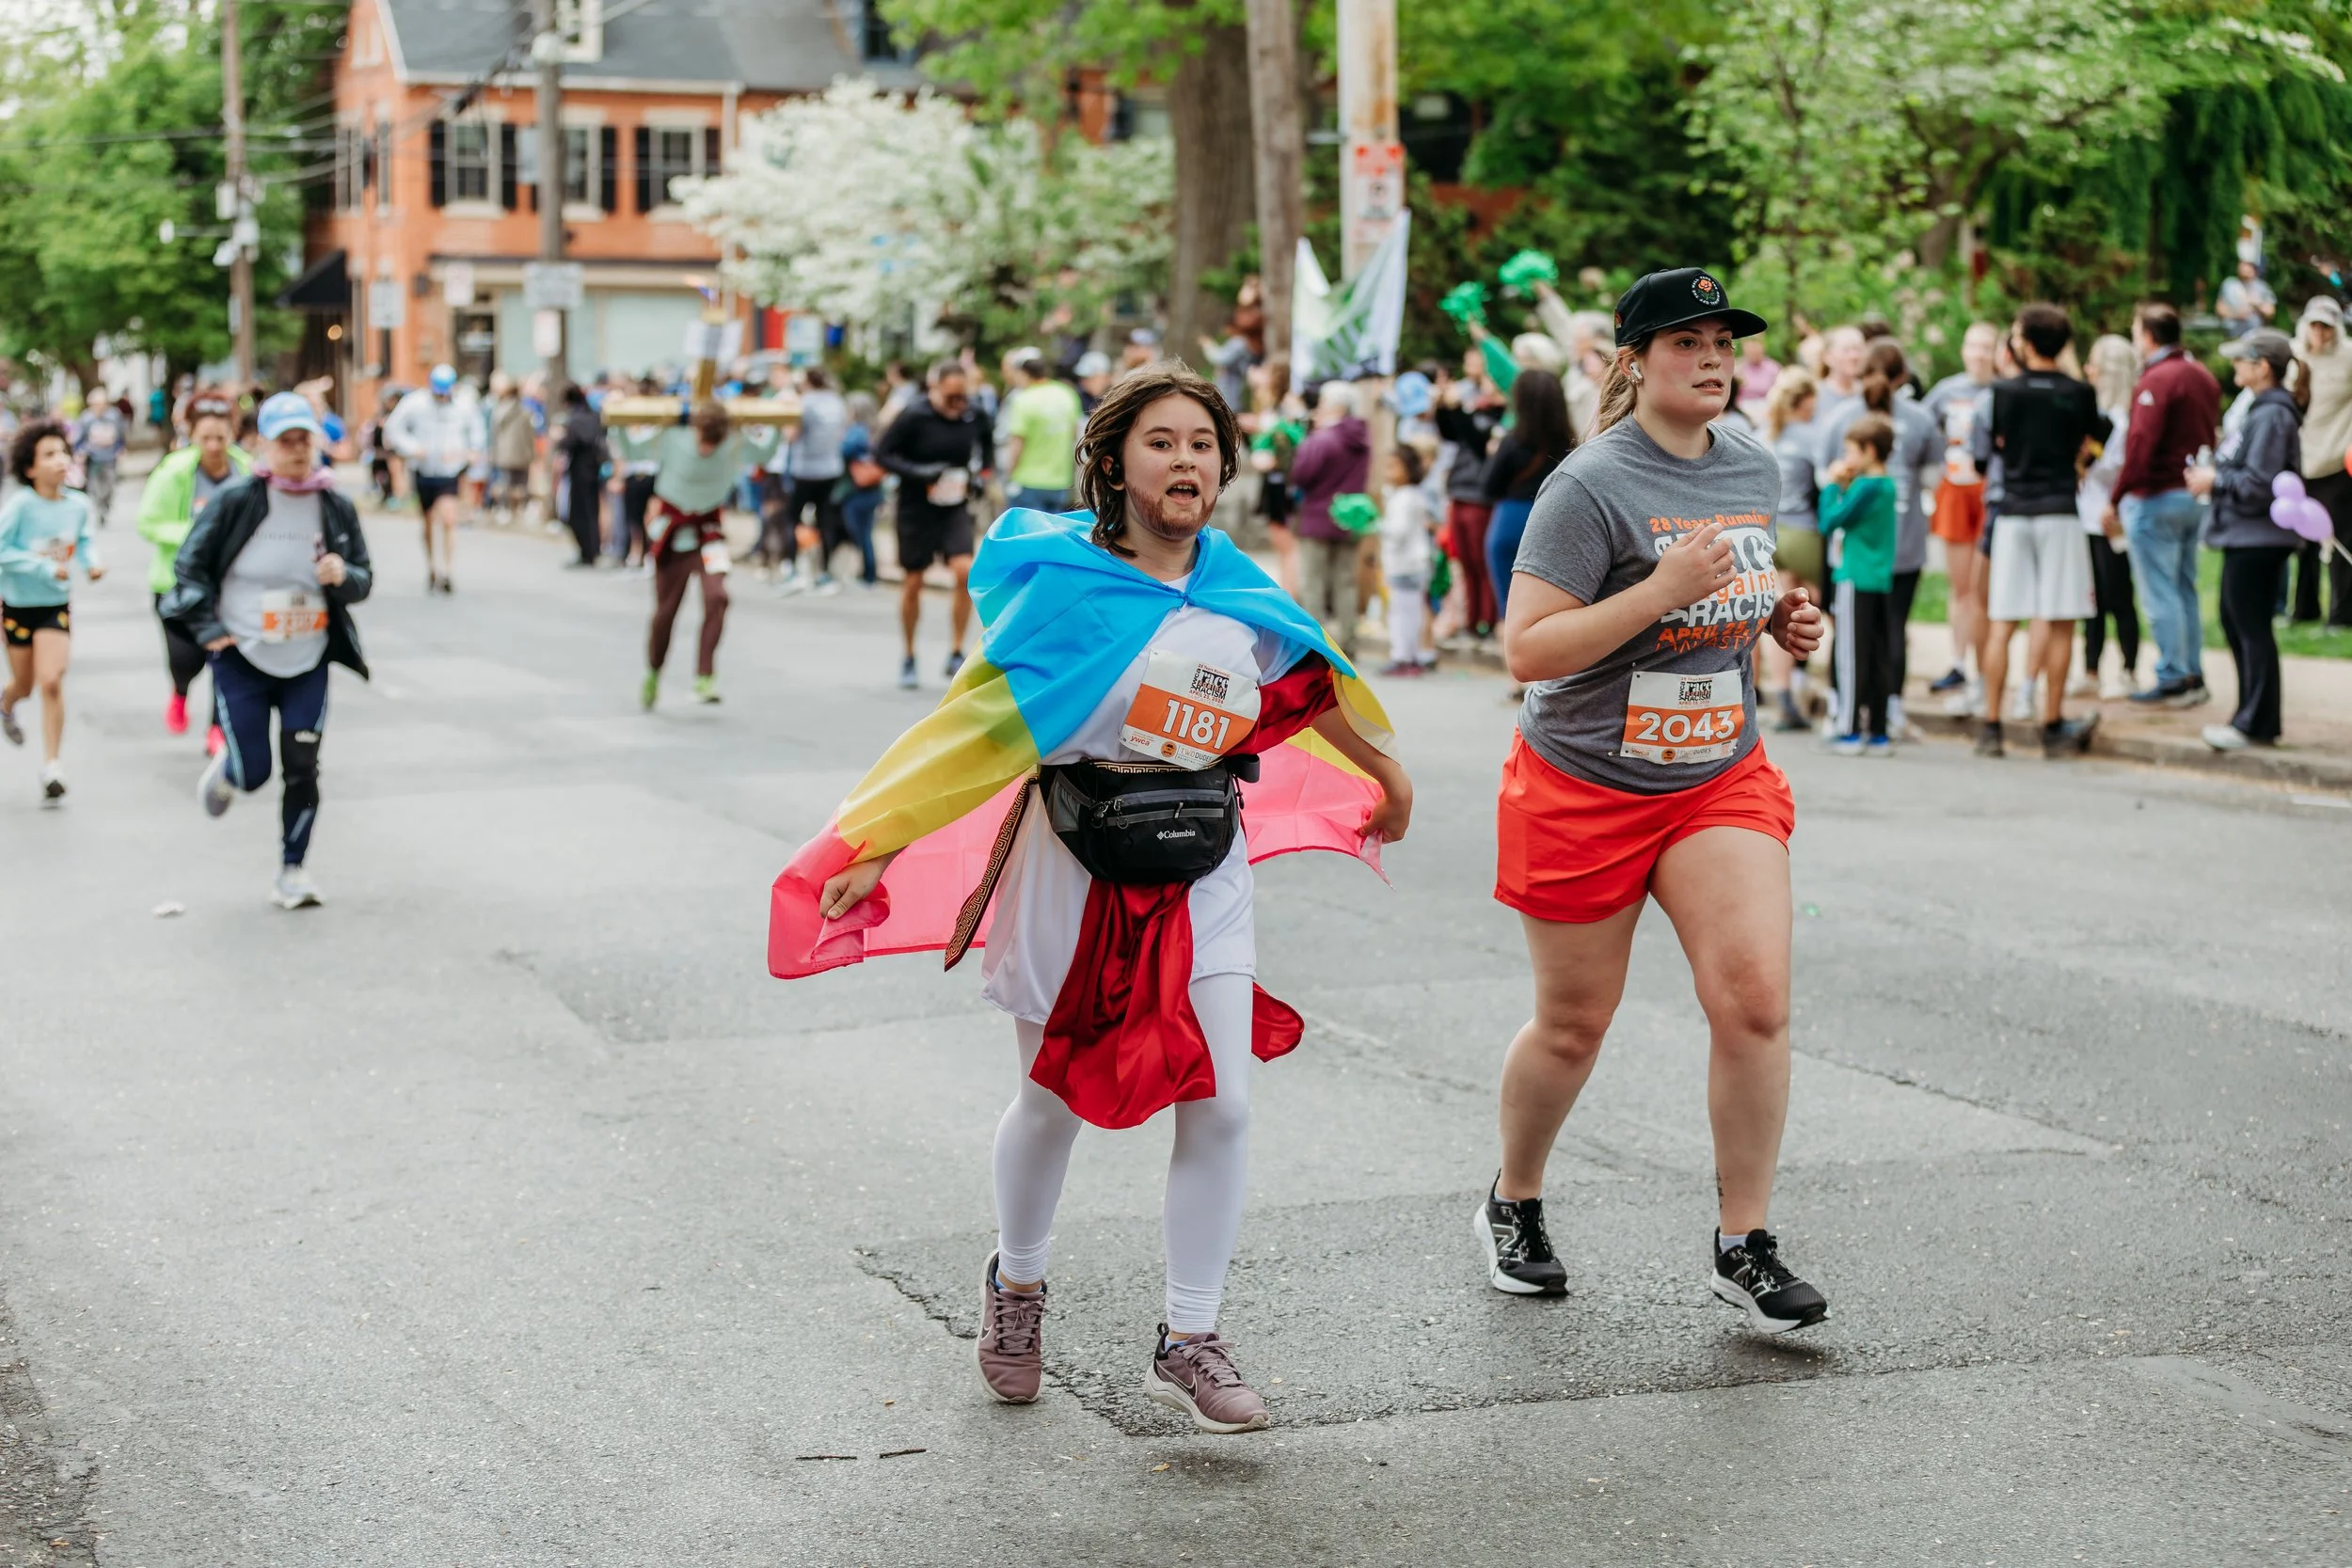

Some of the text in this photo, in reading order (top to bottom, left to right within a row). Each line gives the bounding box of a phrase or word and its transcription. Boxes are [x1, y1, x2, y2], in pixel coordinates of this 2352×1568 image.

[1649, 517, 1672, 533] 28
[1687, 592, 1775, 627] RACIS
[1658, 626, 1719, 643] APRIL
[1200, 671, 1230, 689] race
[1196, 685, 1226, 701] RACISM
[1162, 698, 1231, 751] 1181
[1635, 709, 1736, 744] 2043
[1129, 735, 1152, 748] ywca
[1164, 829, 1196, 839] Columbia
